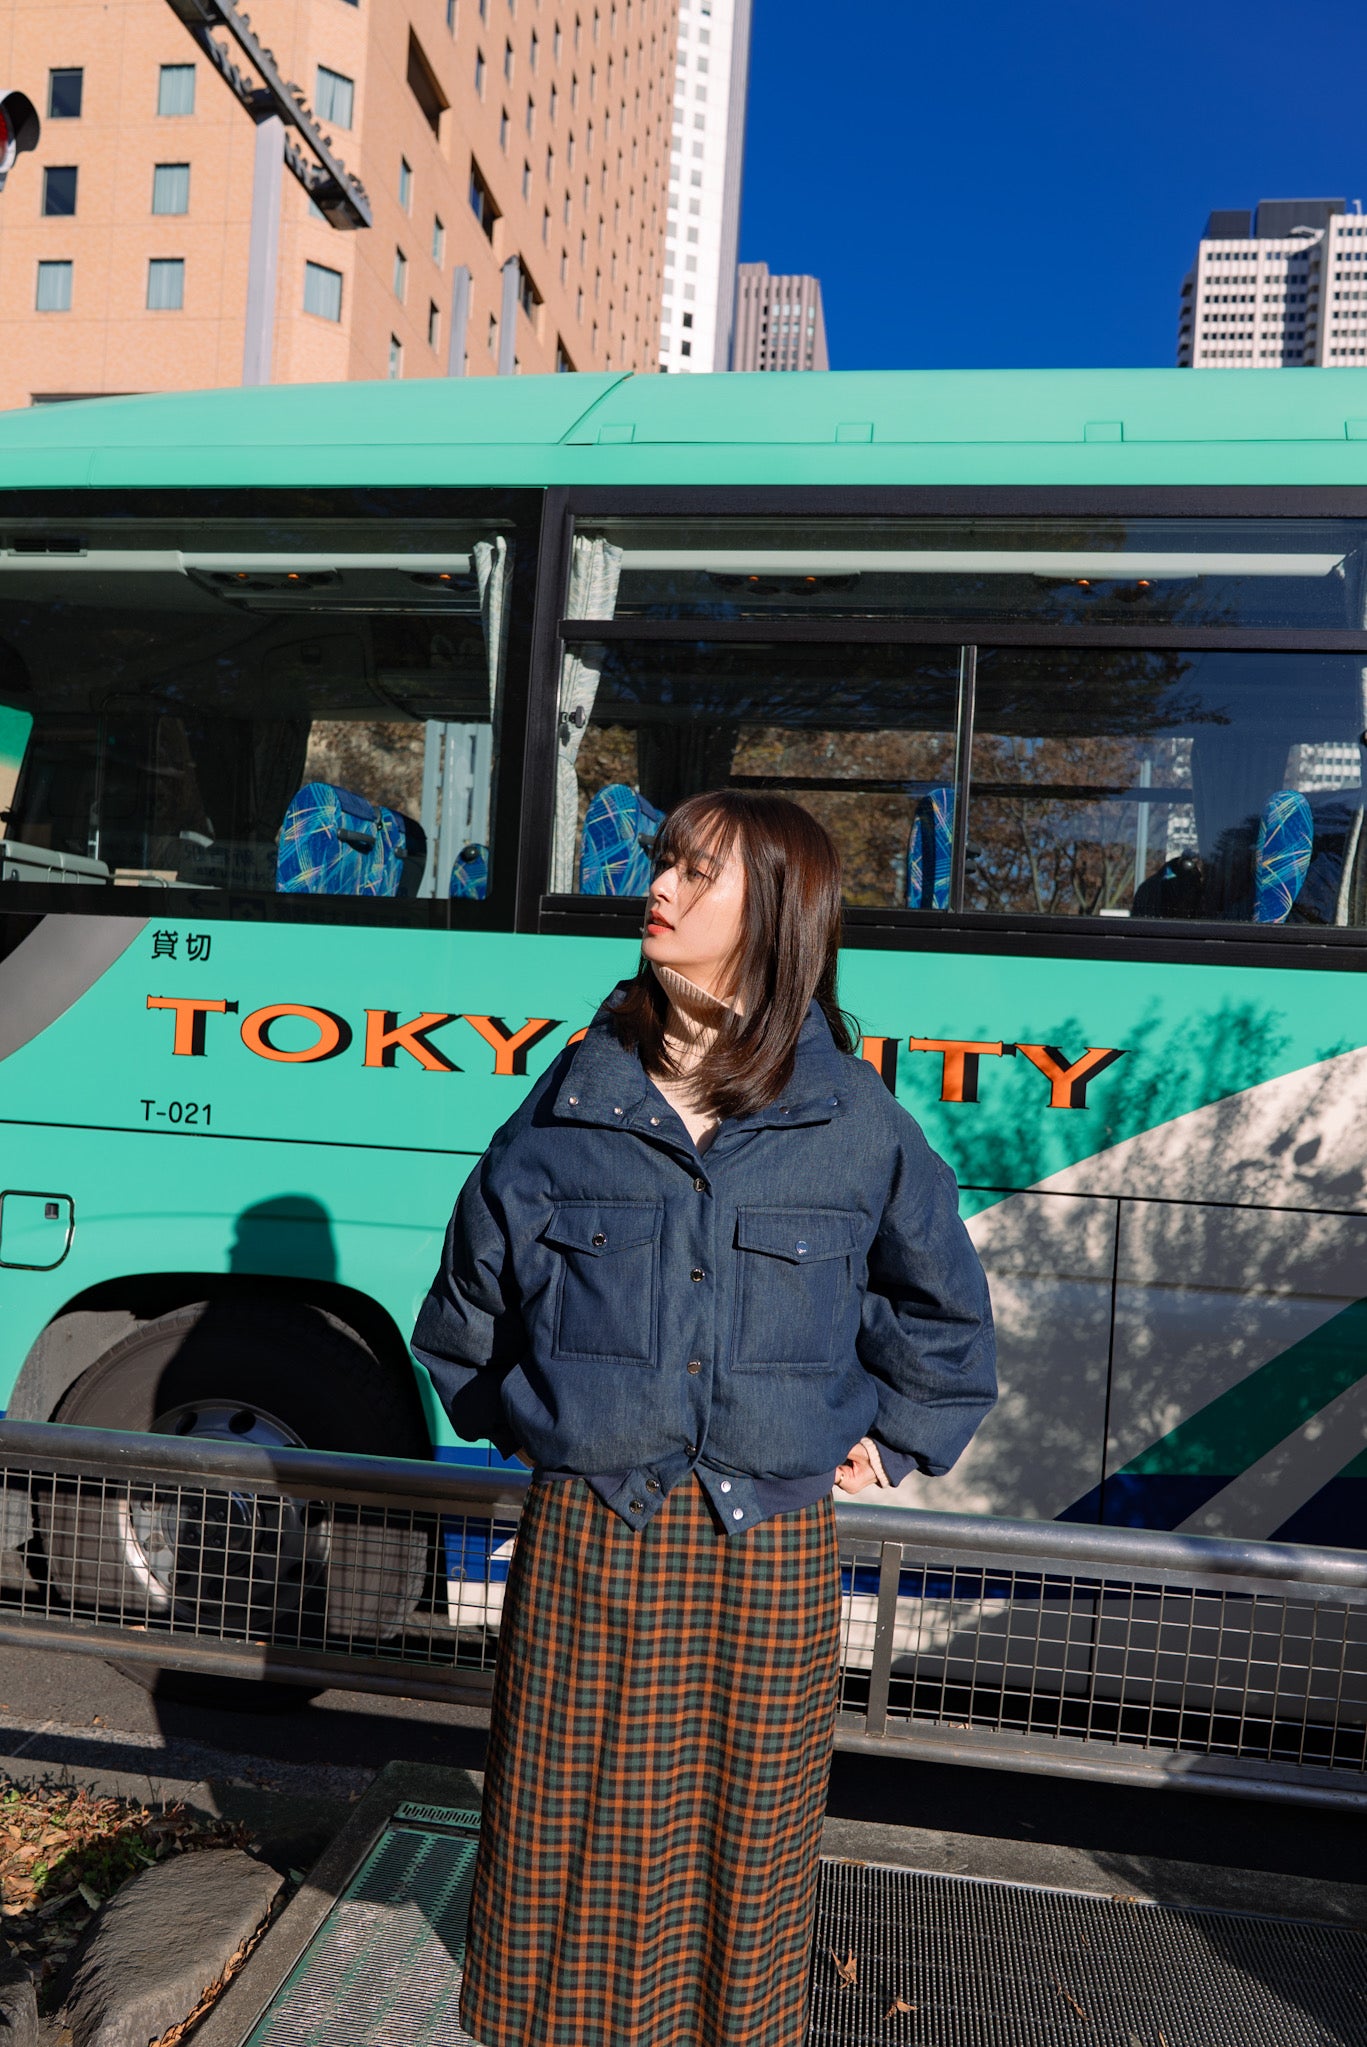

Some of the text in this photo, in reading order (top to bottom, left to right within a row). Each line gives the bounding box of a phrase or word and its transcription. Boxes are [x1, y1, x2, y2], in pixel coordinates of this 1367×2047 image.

[151, 929, 211, 961] 貸切
[146, 994, 1131, 1110] TOKY ITY
[140, 1099, 211, 1126] T-021
